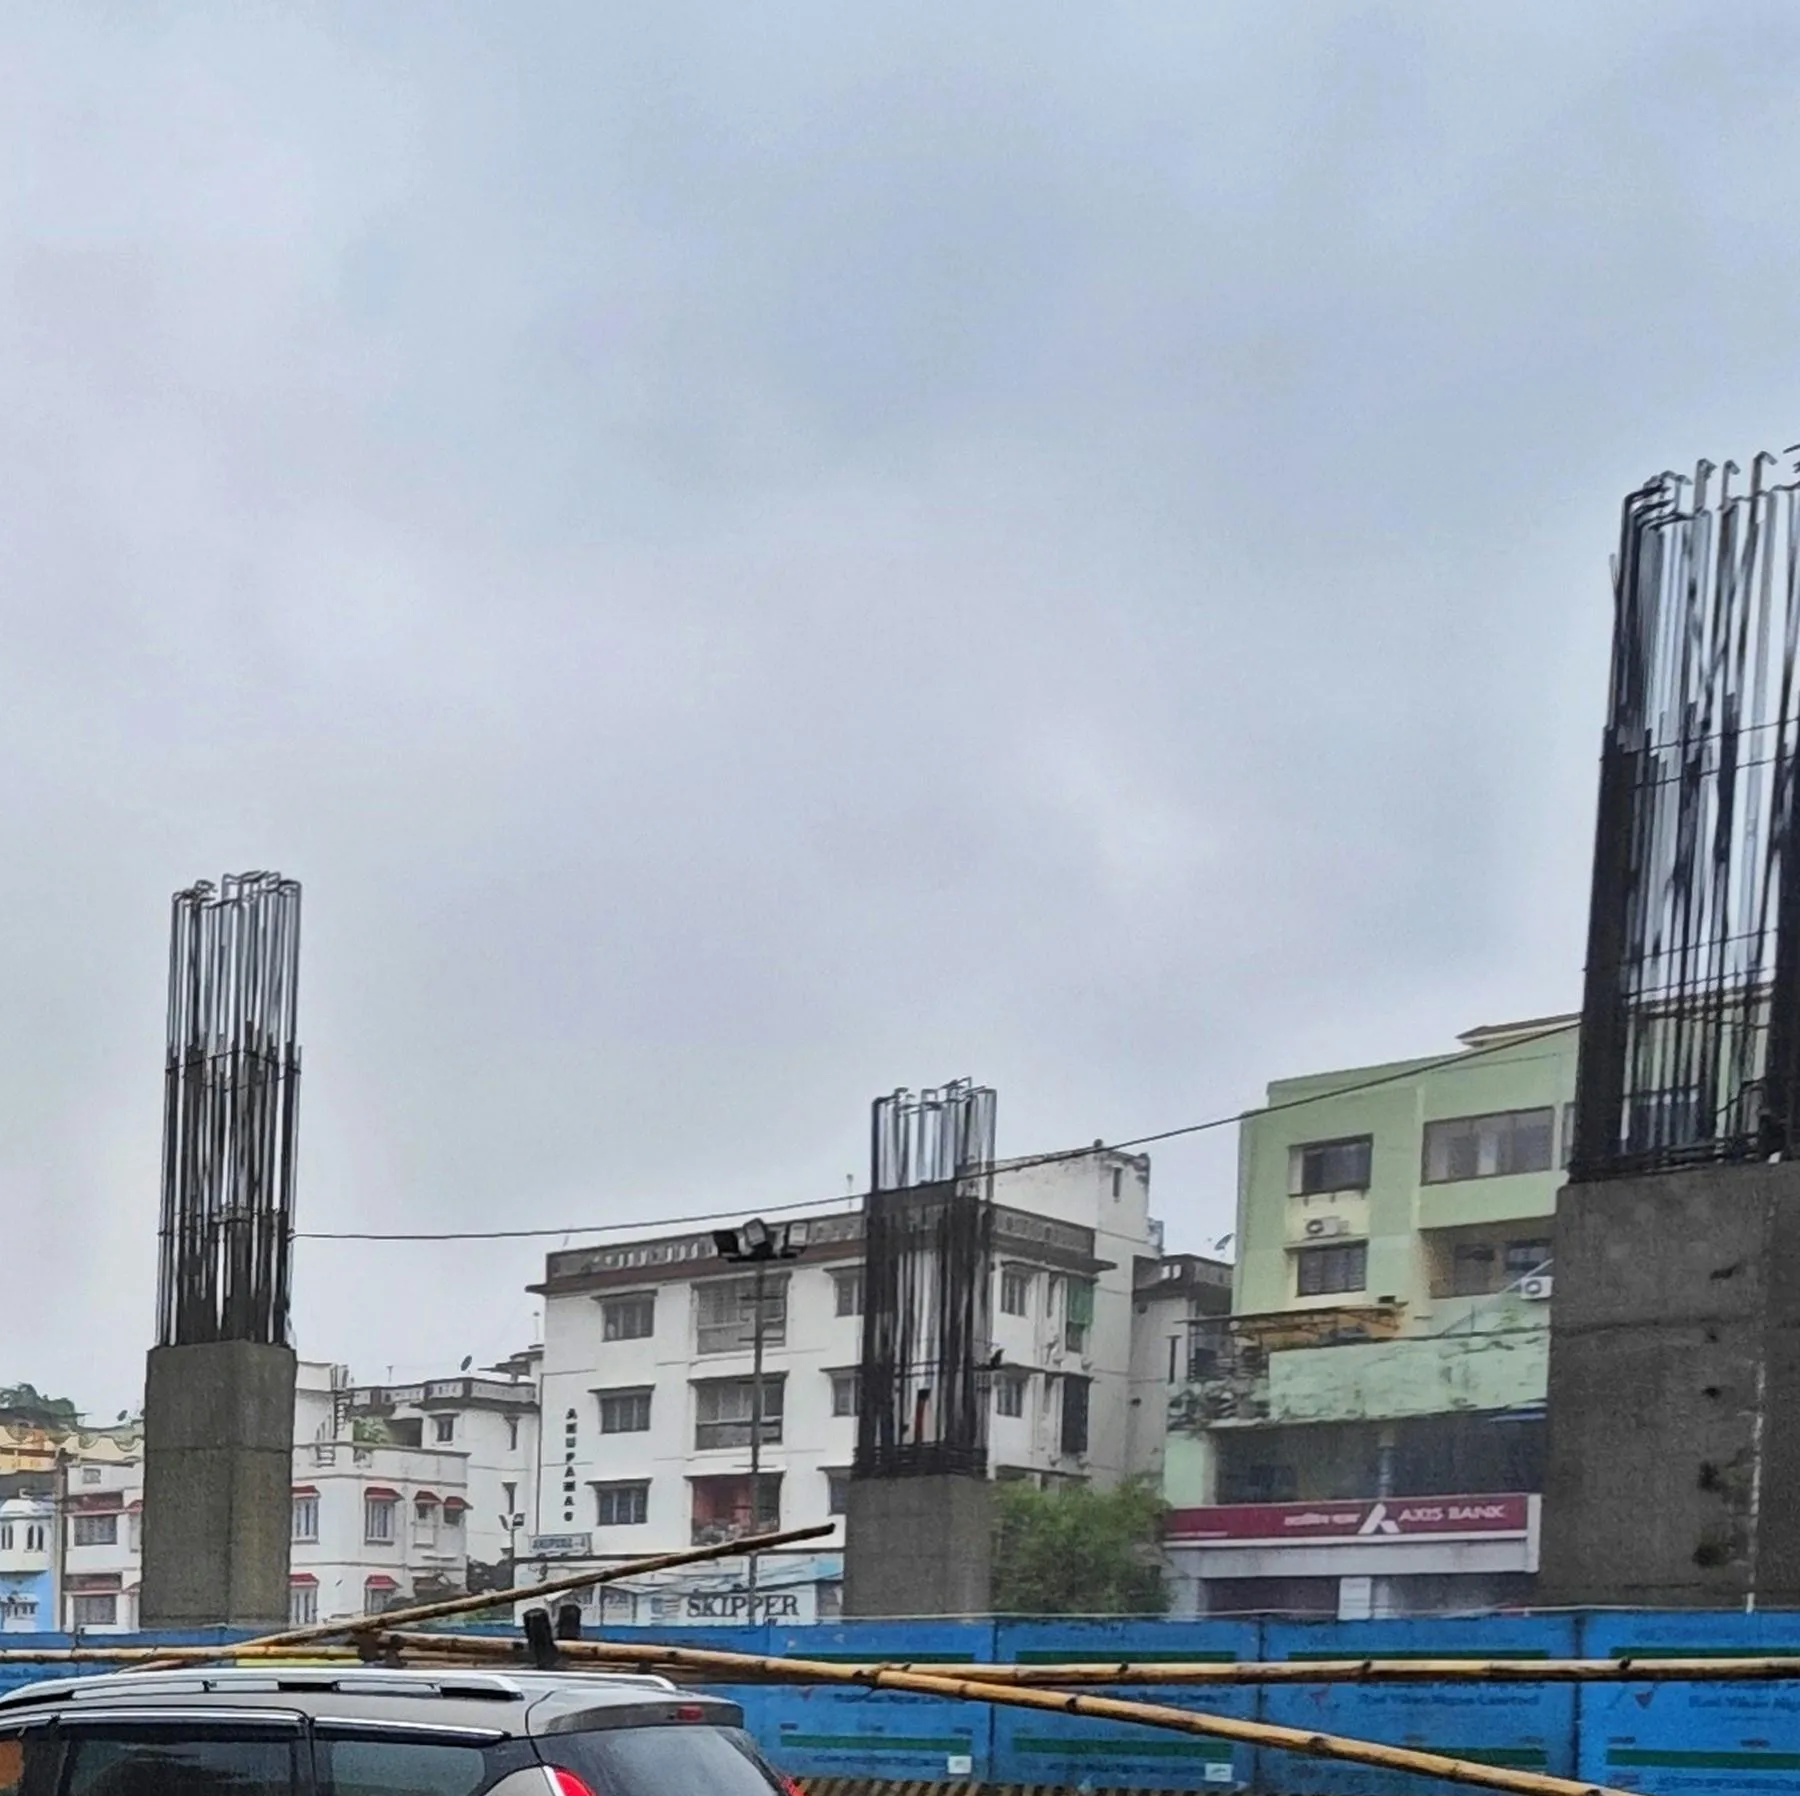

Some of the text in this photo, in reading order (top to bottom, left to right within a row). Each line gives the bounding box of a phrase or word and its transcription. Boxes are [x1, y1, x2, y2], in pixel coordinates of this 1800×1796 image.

[1398, 1504, 1505, 1522] AXIS BANK
[687, 1594, 799, 1617] SKIPPER
